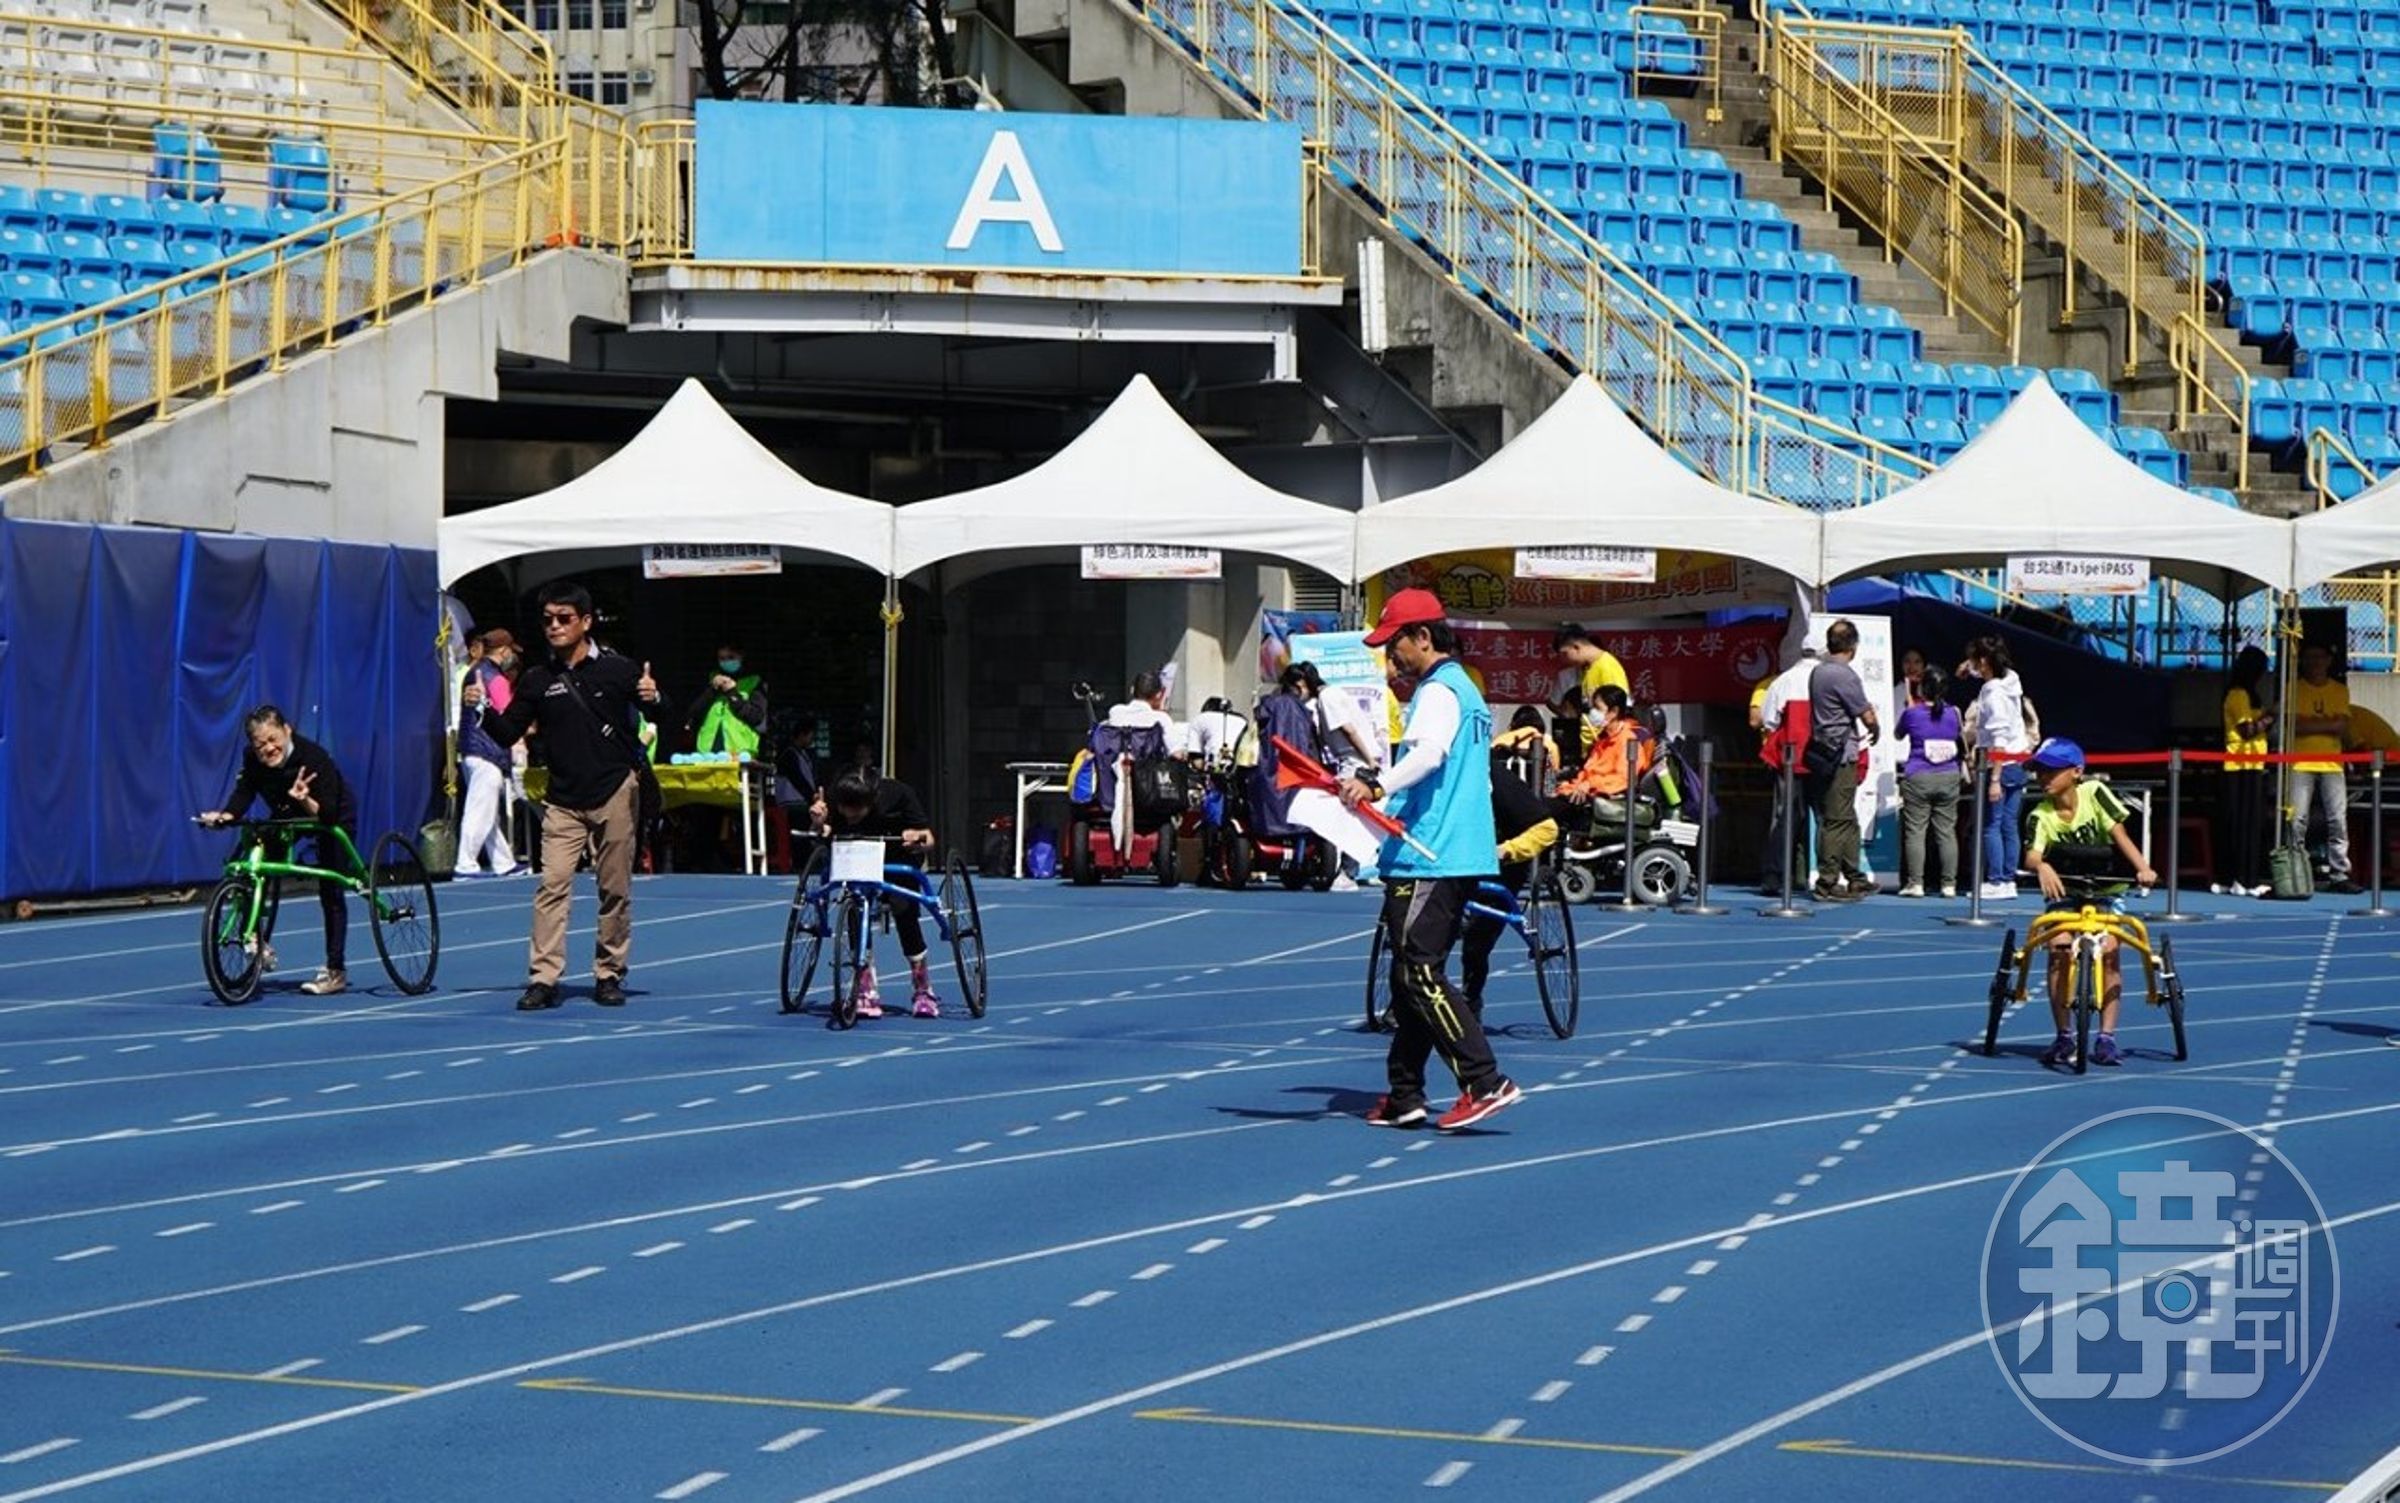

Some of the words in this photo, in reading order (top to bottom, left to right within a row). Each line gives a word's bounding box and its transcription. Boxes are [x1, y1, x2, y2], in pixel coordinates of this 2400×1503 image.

[945, 130, 1065, 251] A
[2024, 560, 2135, 576] 台北通TaipeiPASS
